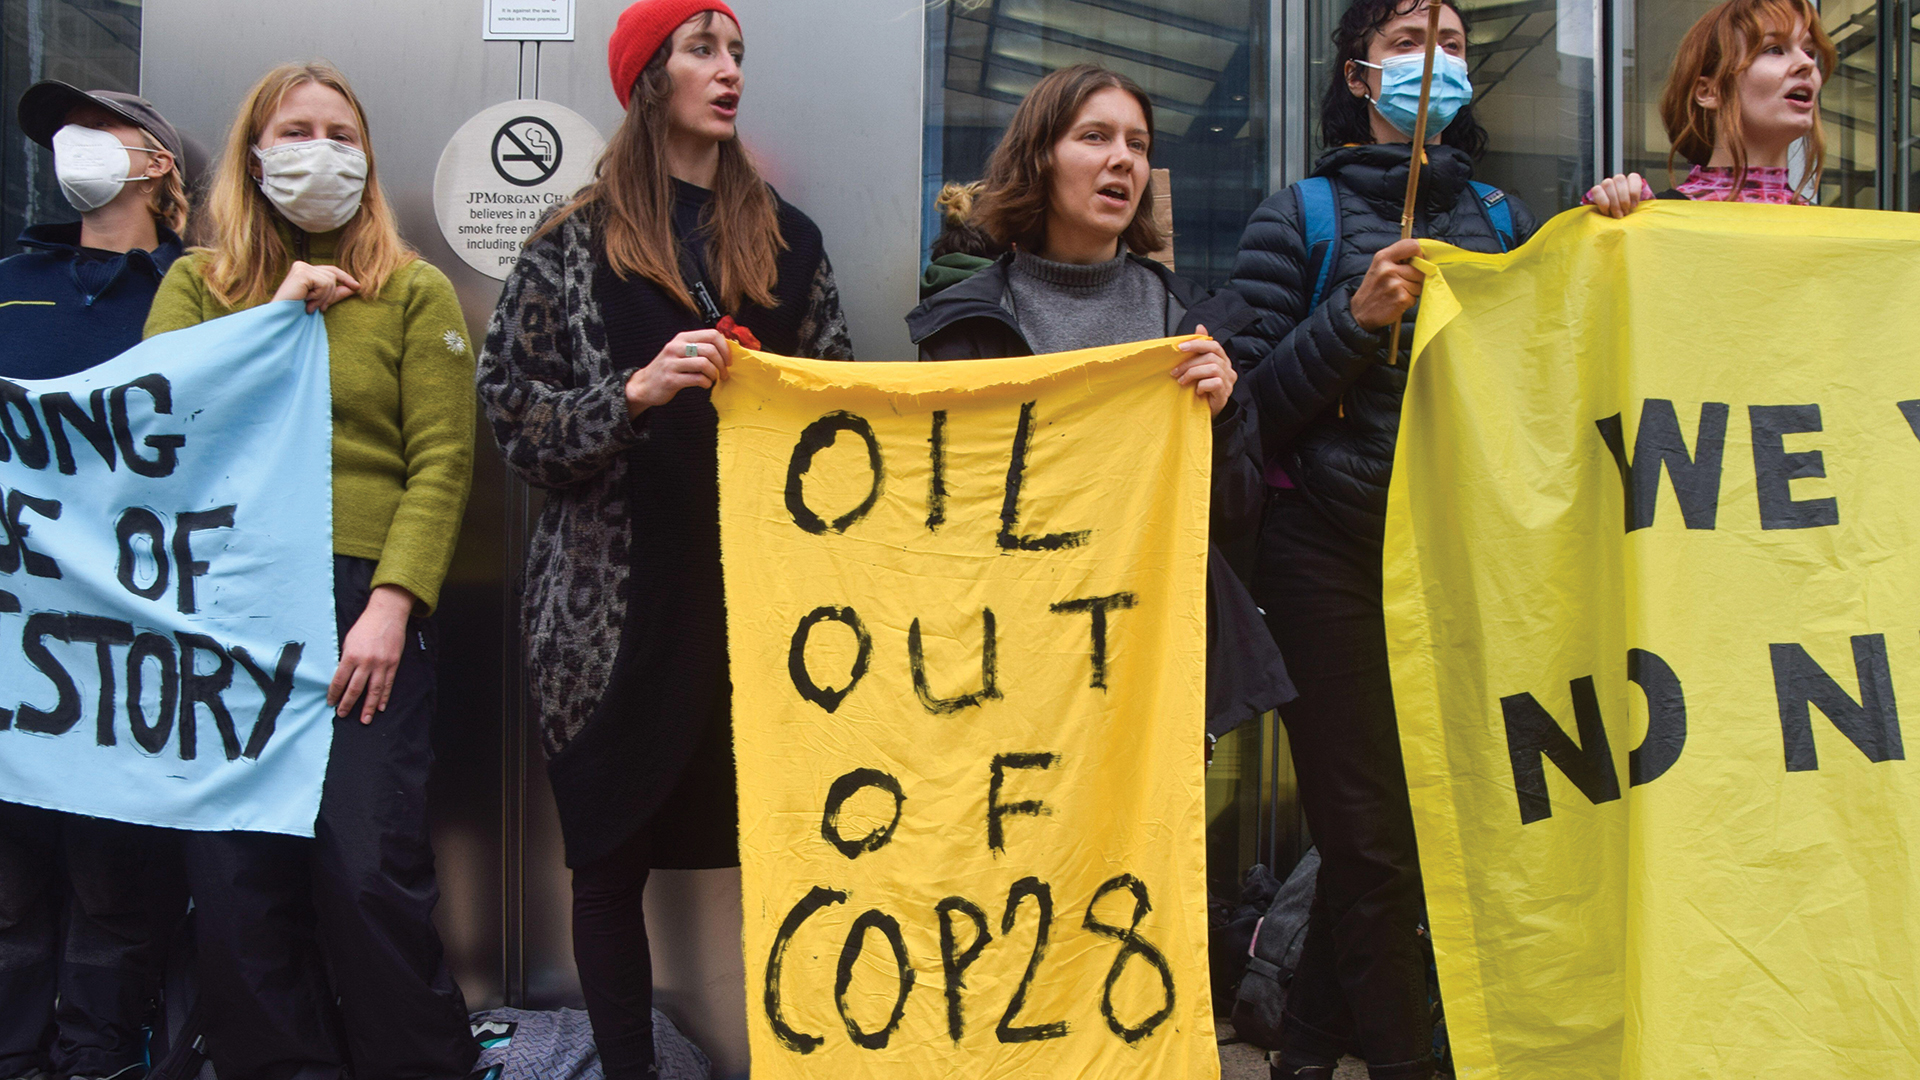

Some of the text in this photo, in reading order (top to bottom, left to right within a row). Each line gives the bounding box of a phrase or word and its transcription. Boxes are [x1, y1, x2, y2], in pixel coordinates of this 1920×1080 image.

[458, 224, 494, 235] smoke
[496, 223, 518, 235] free
[467, 239, 517, 252] including
[470, 208, 514, 220] believes
[516, 208, 526, 219] in
[529, 210, 536, 219] a
[0, 373, 186, 478] ONG
[785, 402, 1091, 552] OIL
[1595, 398, 1839, 534] WE
[115, 503, 237, 614] OF
[0, 589, 306, 761] STORY
[788, 591, 1139, 713] OUT
[1500, 647, 1688, 825] NO
[821, 752, 1060, 859] OF
[764, 872, 1177, 1052] COP28
